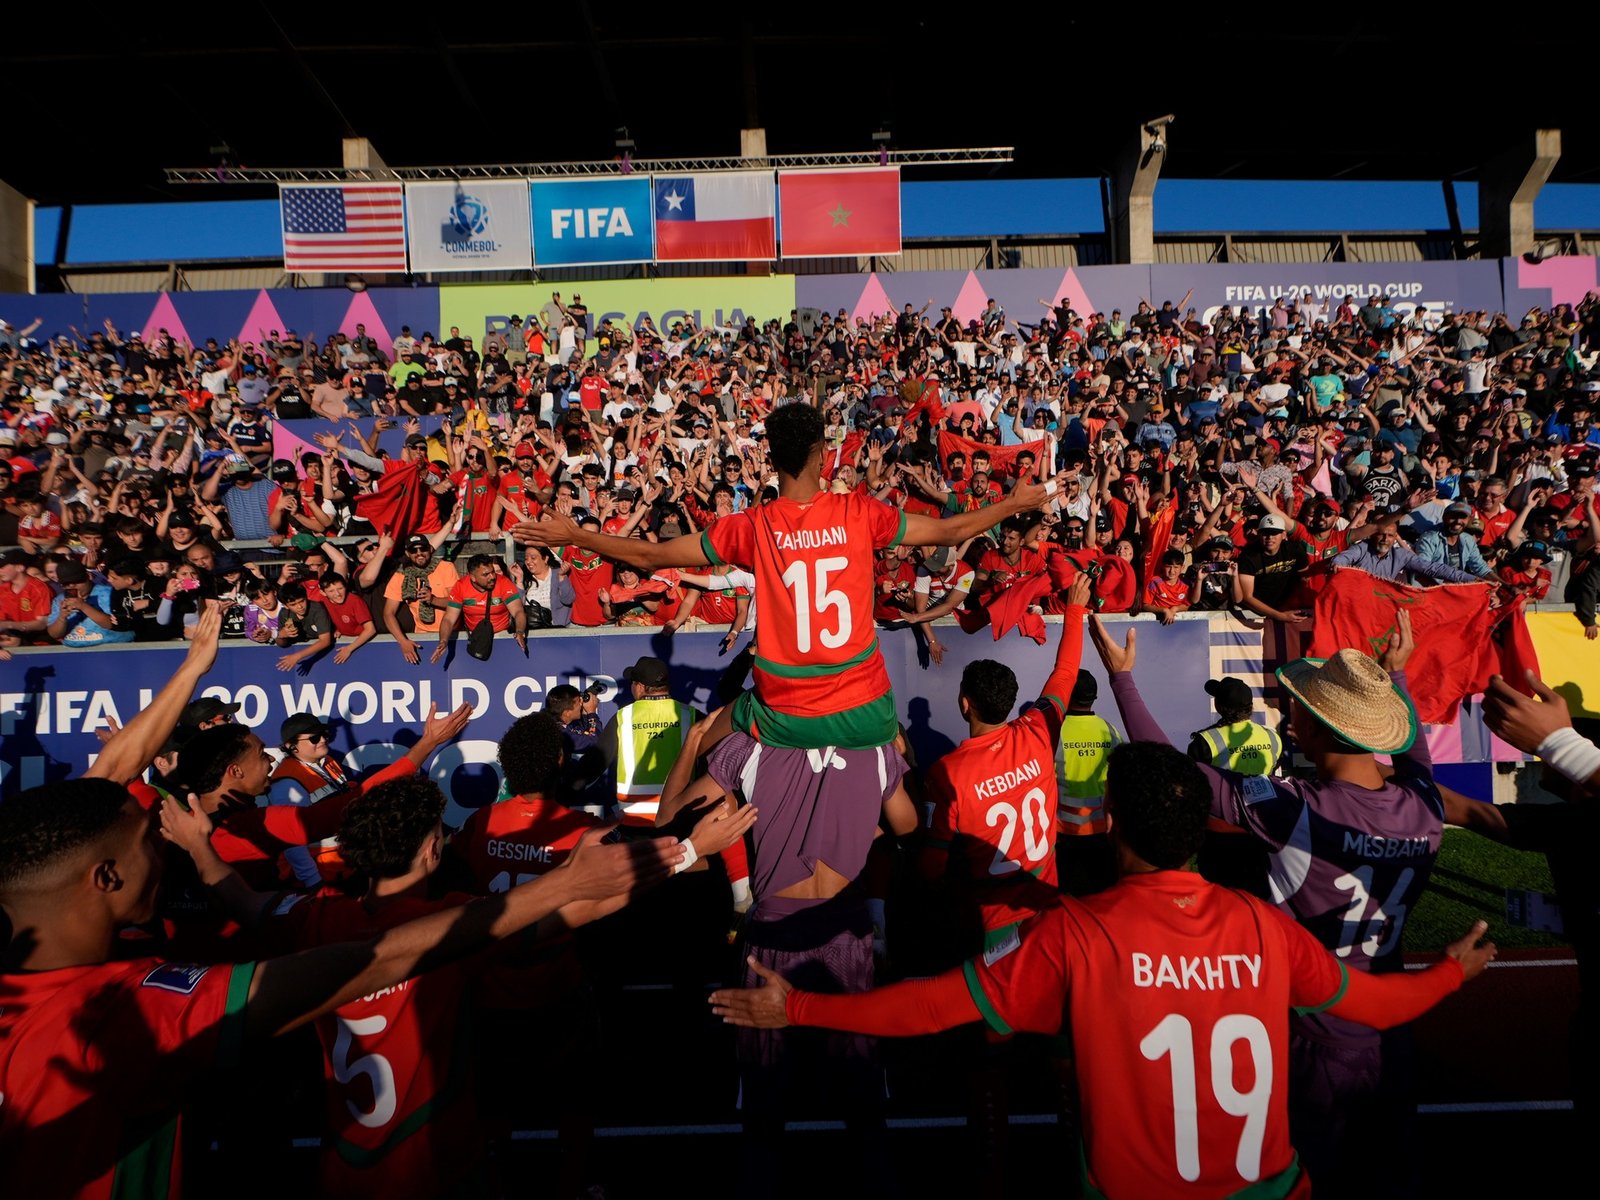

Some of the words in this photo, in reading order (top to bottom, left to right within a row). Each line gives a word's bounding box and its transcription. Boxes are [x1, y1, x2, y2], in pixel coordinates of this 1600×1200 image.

[551, 207, 634, 239] FIFA
[445, 240, 498, 253] CONMEBOL
[1225, 285, 1266, 301] FIFA
[1314, 283, 1382, 299] WORLD
[1384, 282, 1423, 298] CUP
[1364, 479, 1400, 494] PARIS
[1373, 491, 1390, 507] 23
[774, 526, 847, 551] ZAHOUANI
[782, 556, 852, 654] 15
[0, 690, 123, 735] FIFA
[280, 677, 491, 728] WORLD
[632, 721, 680, 730] SEGURIDAD
[647, 731, 664, 740] 724
[1063, 741, 1111, 749] SEGURIDAD
[1078, 749, 1096, 757] 613
[1241, 751, 1258, 760] 610
[974, 759, 1041, 800] KEBDANI
[985, 787, 1050, 875] 20
[487, 839, 553, 863] GESSIME
[1343, 831, 1430, 859] MESBAHI
[1334, 864, 1415, 958] 16
[1132, 952, 1262, 991] BAKHTY
[332, 1014, 397, 1128] 5
[1140, 1013, 1273, 1182] 19
